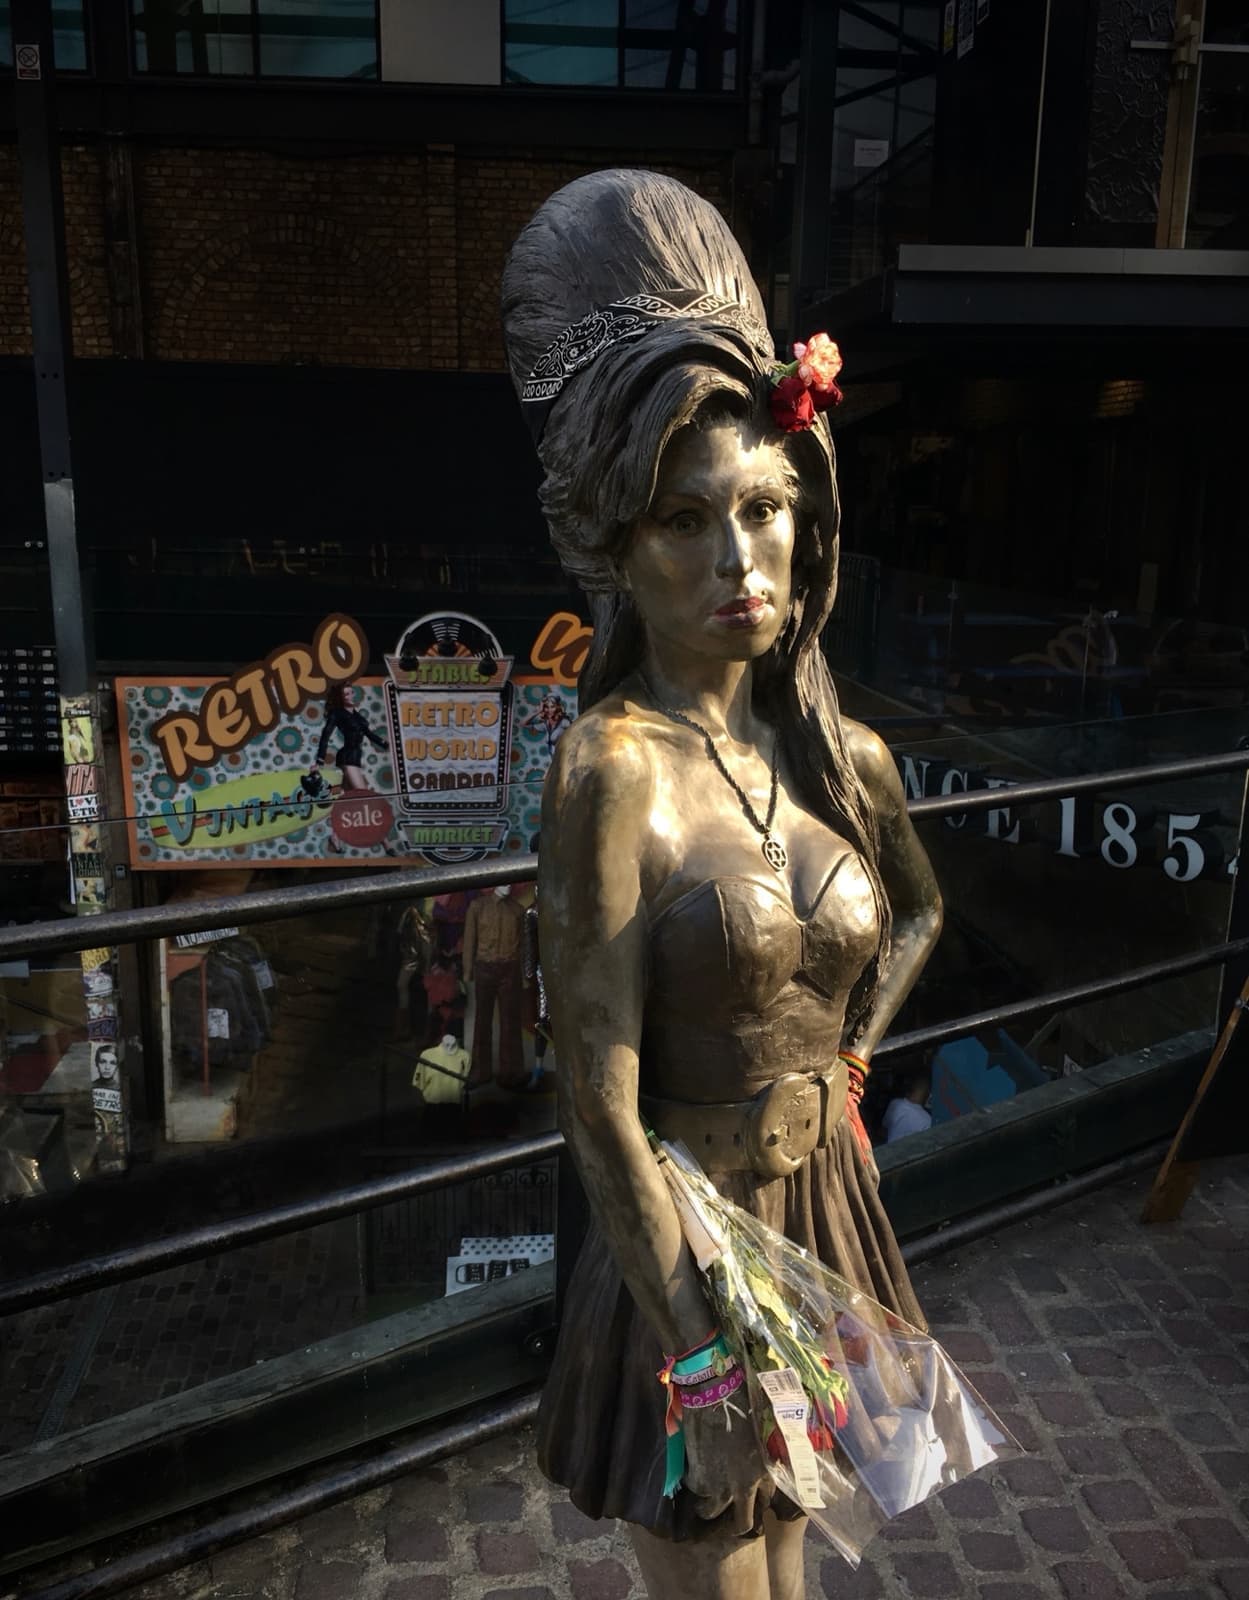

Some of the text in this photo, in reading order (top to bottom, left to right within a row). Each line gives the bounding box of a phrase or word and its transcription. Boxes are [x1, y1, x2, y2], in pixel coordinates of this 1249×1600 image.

[155, 617, 365, 779] RETRO
[401, 701, 499, 727] RETRO
[405, 738, 496, 760] WORLD
[409, 772, 495, 789] CAMDEN
[341, 804, 383, 828] sale
[414, 826, 493, 845] MARKET
[1054, 796, 1239, 882] 185
